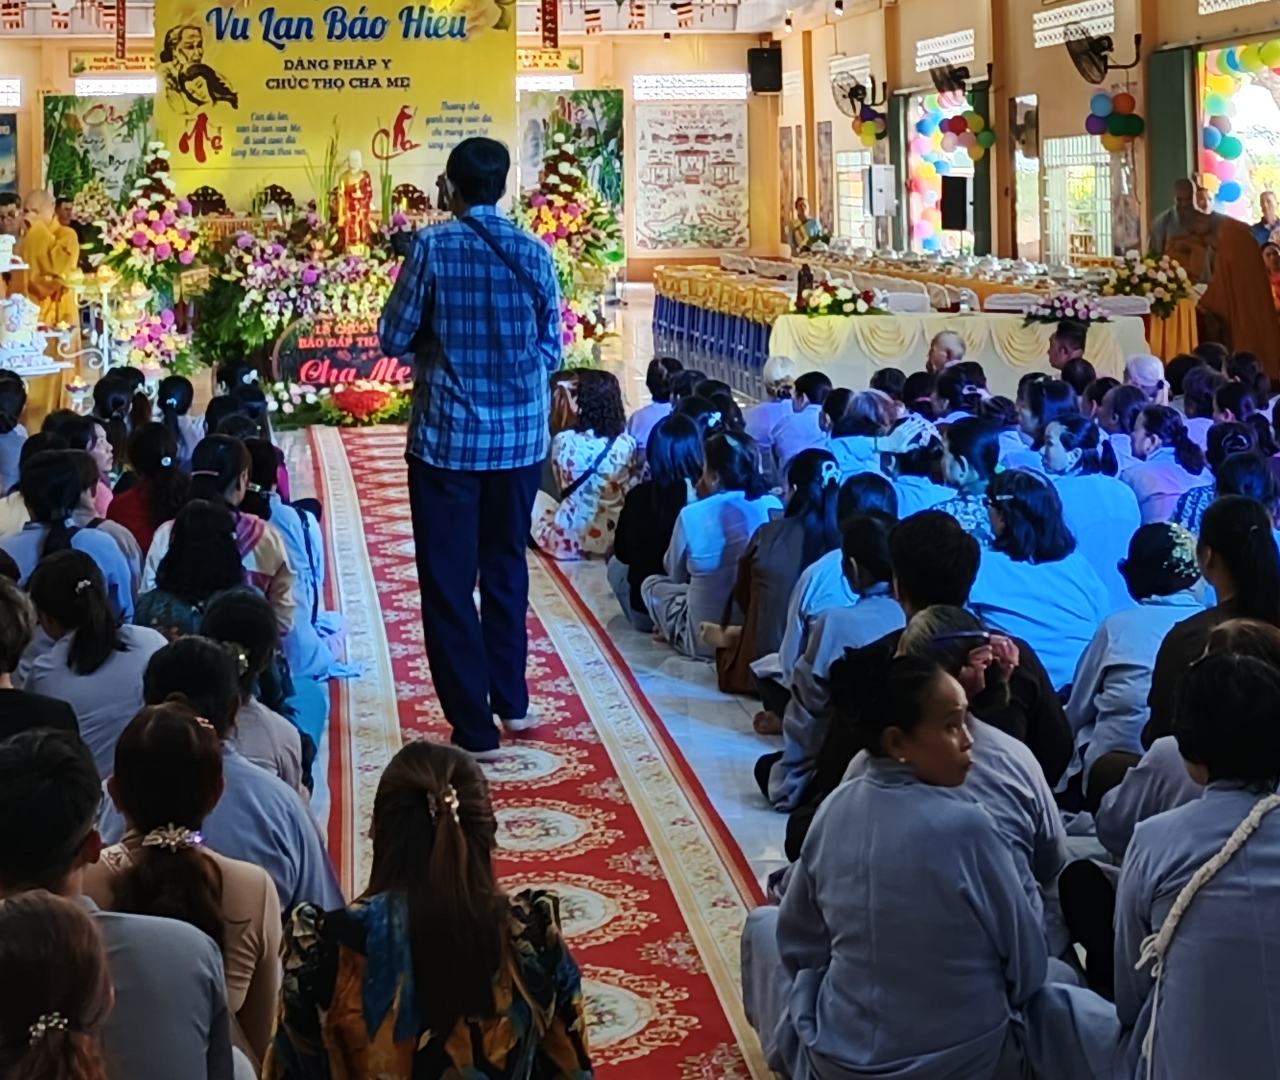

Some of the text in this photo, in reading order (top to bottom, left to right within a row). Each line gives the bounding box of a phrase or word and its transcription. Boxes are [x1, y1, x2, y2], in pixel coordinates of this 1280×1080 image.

[205, 4, 250, 42] Vu
[257, 4, 316, 51] Lan
[322, 3, 391, 42] Báo
[381, 58, 394, 72] Y
[348, 76, 383, 91] CHA
[385, 75, 412, 93] MẸ
[299, 357, 358, 384] Cha
